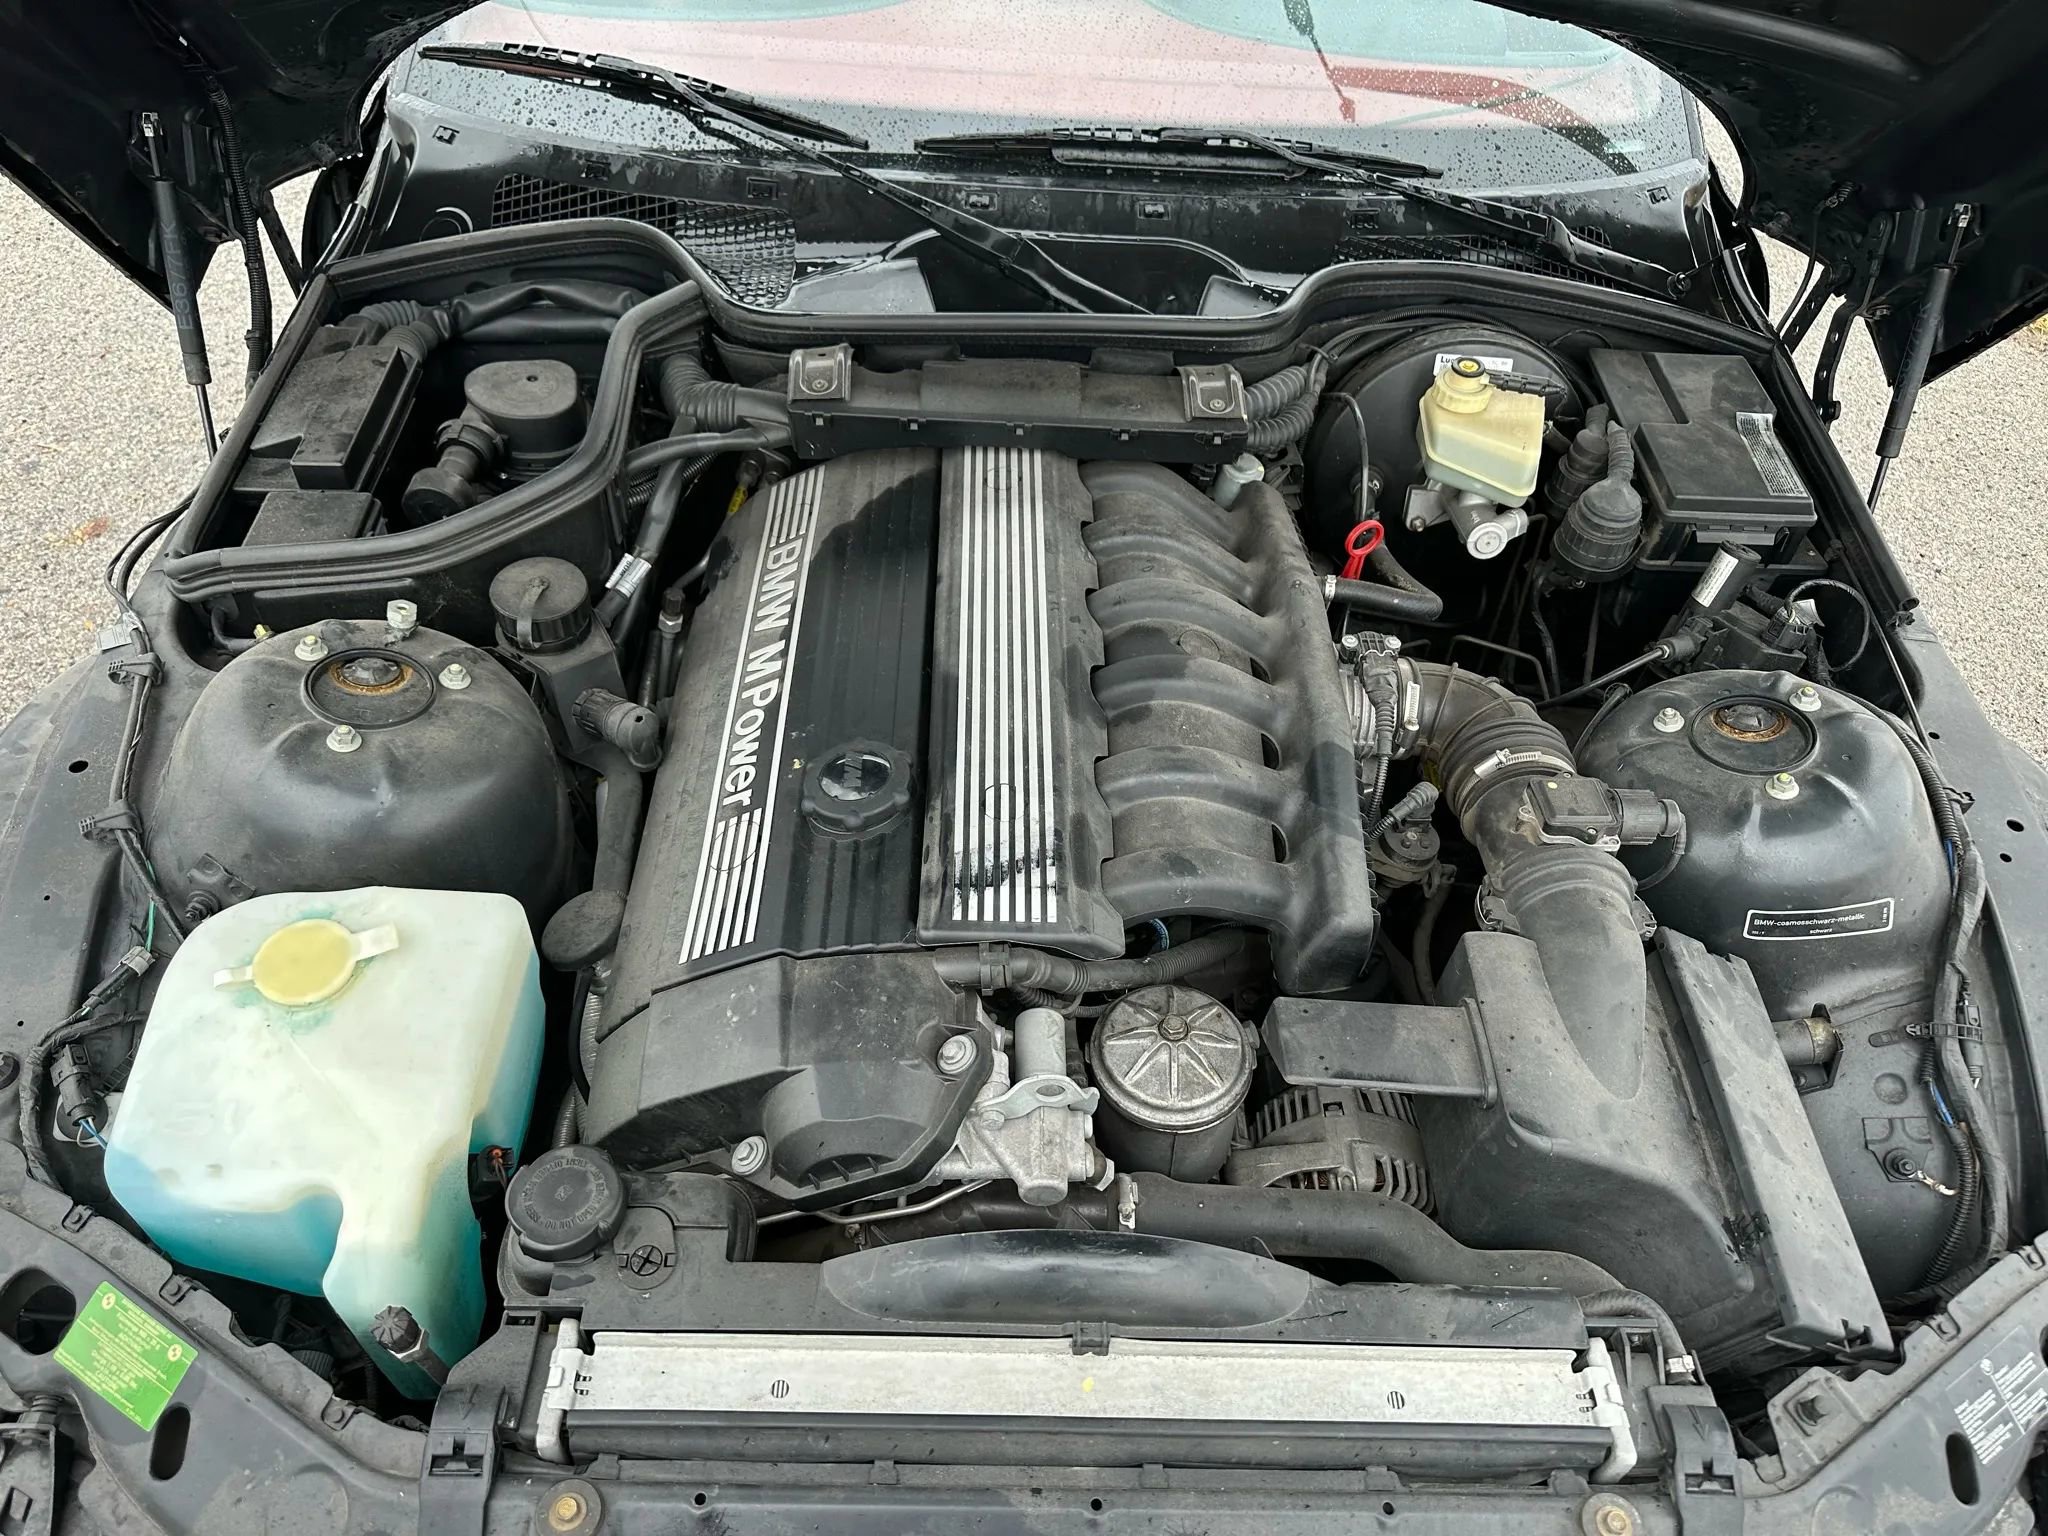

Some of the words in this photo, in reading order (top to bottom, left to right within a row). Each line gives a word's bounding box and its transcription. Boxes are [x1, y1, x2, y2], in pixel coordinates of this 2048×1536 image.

[754, 538, 803, 632] BMW
[723, 639, 785, 806] MPower
[1754, 912, 1865, 927] BMW-cosmosschwarz-metallic
